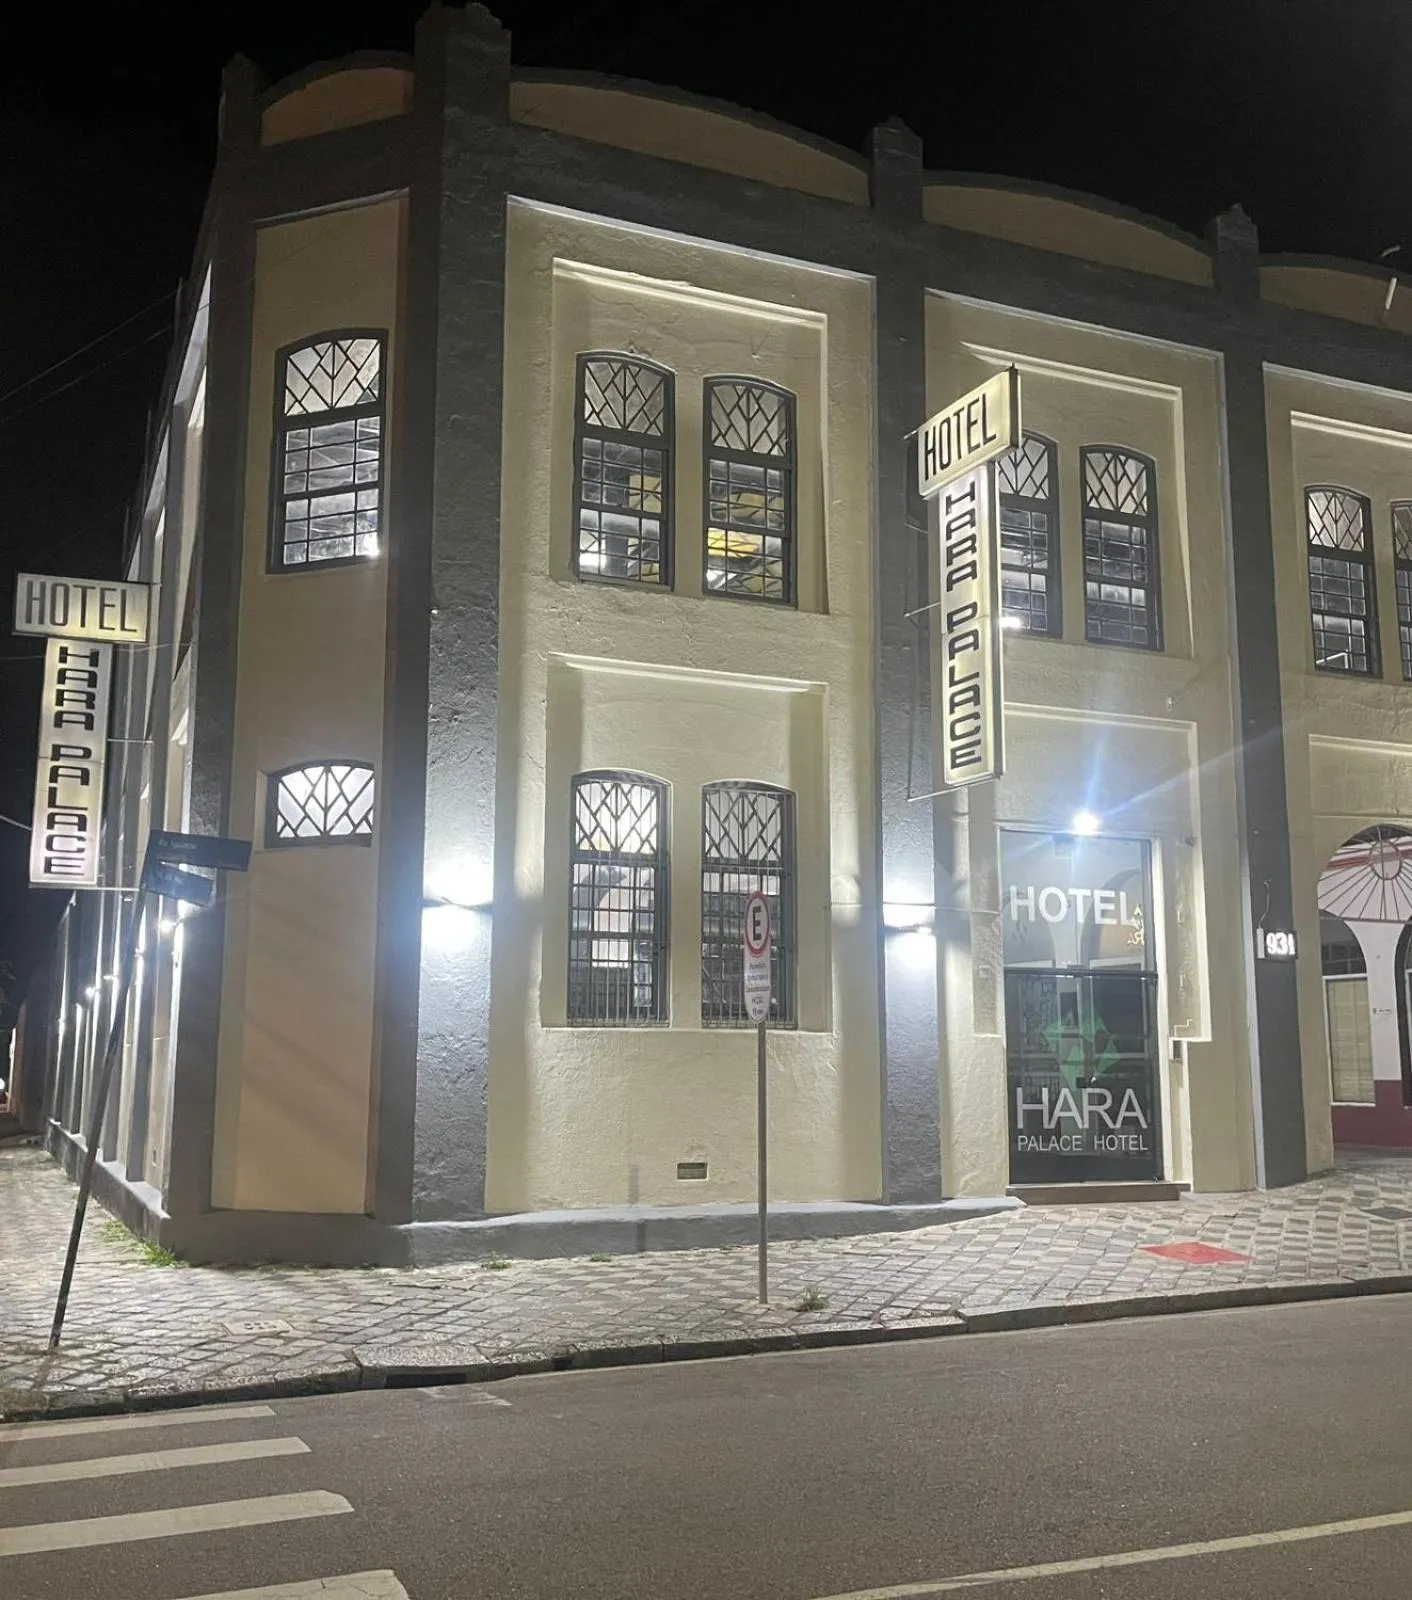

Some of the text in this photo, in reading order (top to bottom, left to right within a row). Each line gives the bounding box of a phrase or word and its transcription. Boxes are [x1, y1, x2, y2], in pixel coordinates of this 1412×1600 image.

[923, 392, 997, 481] HOTEL
[24, 579, 138, 633] HOTEL
[945, 481, 982, 771] HARA PALACE
[44, 645, 100, 877] HARA PALACE
[752, 905, 762, 941] E
[1008, 884, 1133, 926] HOTEL
[1265, 931, 1296, 956] 931
[1016, 1086, 1149, 1130] HARA
[1017, 1134, 1149, 1152] PALACE HOTEL
